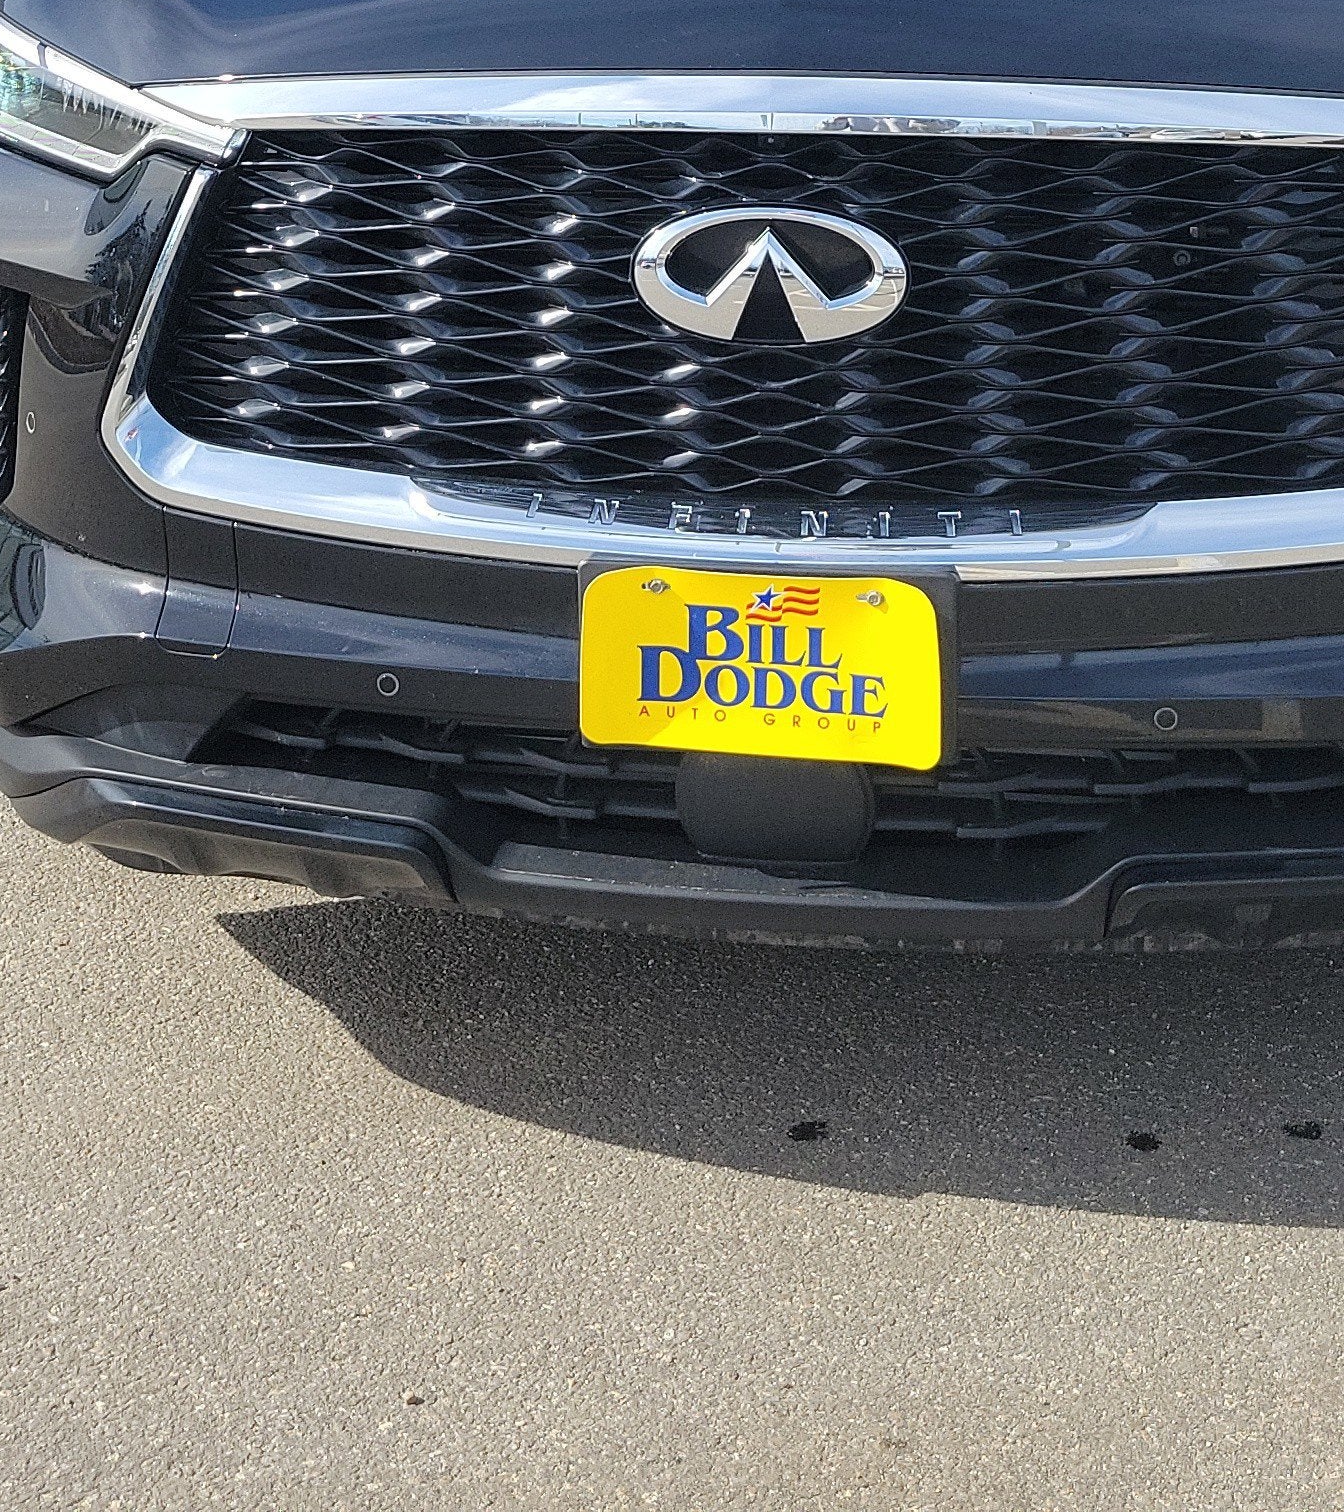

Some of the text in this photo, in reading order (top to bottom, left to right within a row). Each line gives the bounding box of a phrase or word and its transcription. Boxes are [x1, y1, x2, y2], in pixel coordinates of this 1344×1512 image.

[525, 492, 1024, 538] INFINITI
[684, 603, 844, 670] BILL
[636, 644, 889, 719] DODGE
[638, 705, 883, 734] AUTO GROUP
